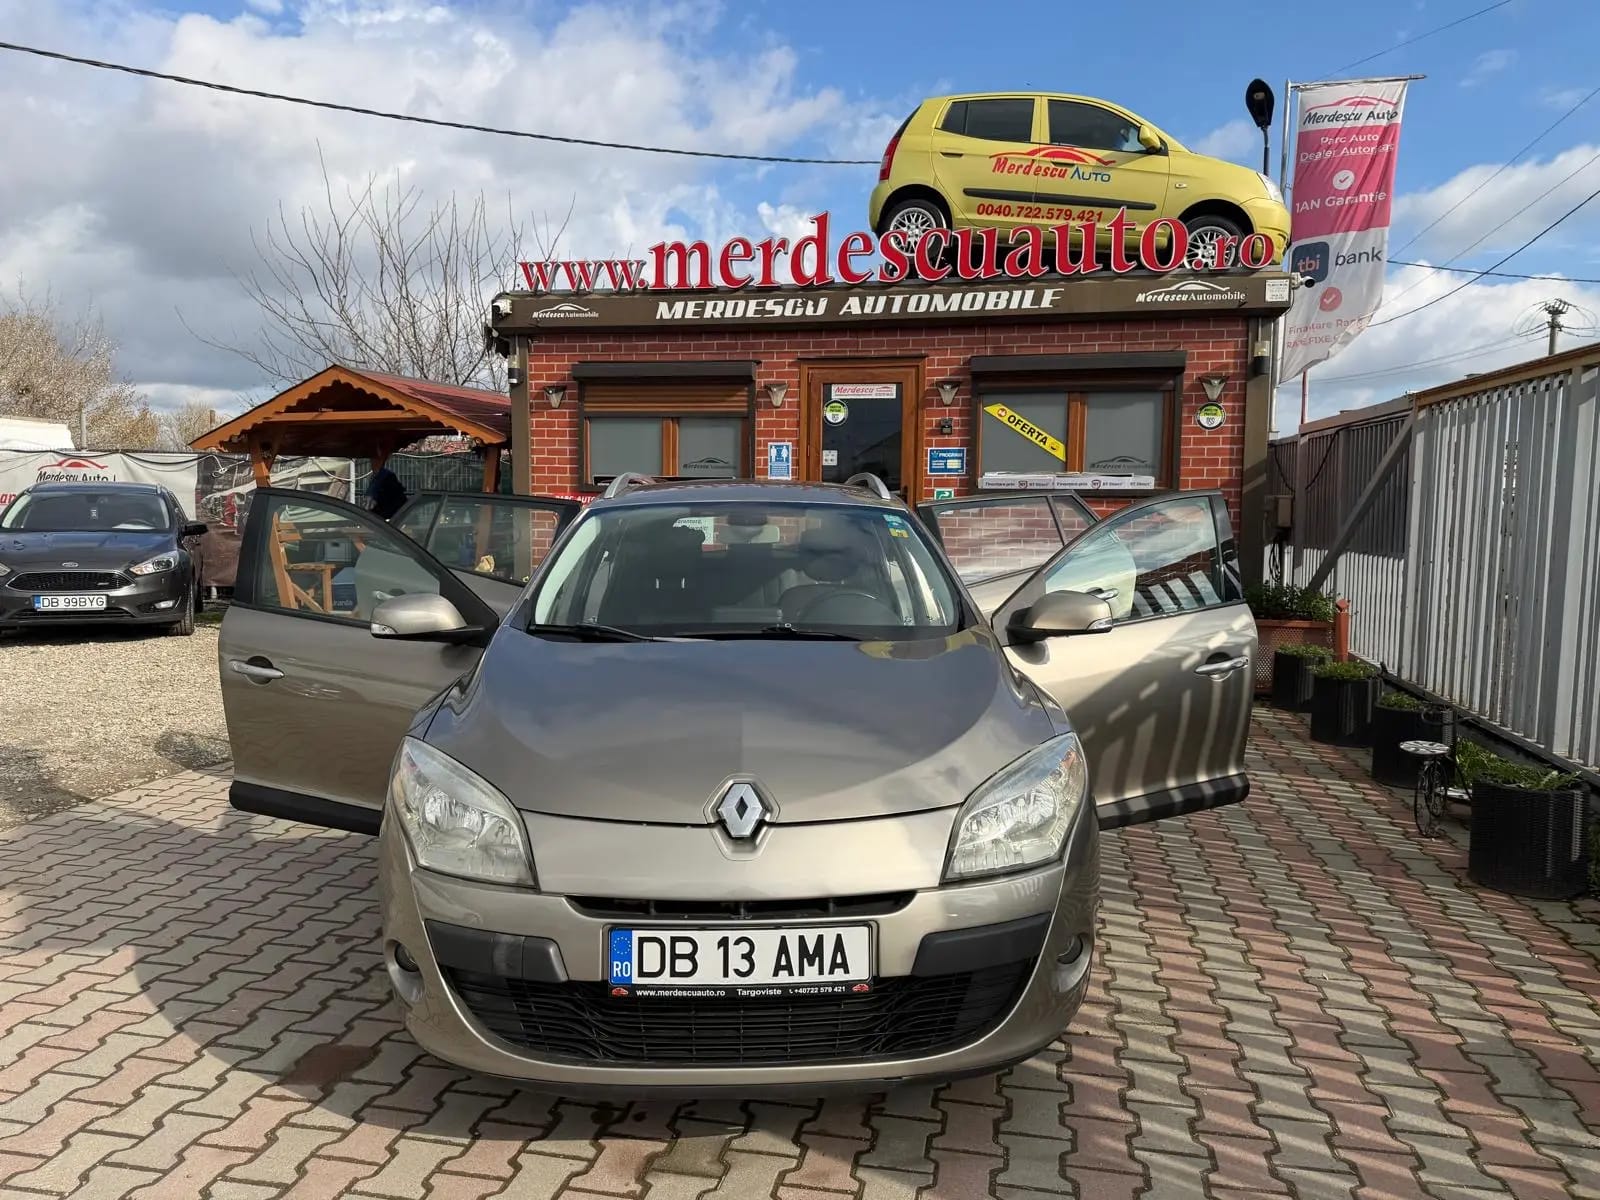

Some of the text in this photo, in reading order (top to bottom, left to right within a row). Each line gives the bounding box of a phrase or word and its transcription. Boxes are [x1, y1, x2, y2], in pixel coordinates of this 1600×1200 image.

[1303, 109, 1398, 125] Merdescu Auto
[1321, 133, 1379, 145] Parc Auto
[992, 157, 1067, 178] Merdescu
[1325, 191, 1387, 207] Garantie
[976, 203, 1104, 222] 0040.722.579.421
[519, 205, 1274, 292] www.merdescuauto.ro
[1298, 246, 1382, 272] tbi bank
[655, 288, 1064, 320] MERDESCU AUTOMOBILE
[834, 386, 875, 394] Merdescu
[1007, 414, 1048, 445] OFERTA
[42, 598, 59, 607] DB
[63, 597, 105, 607] 99BYG
[612, 933, 850, 978] RO DB 13 AMA
[636, 988, 725, 997] www.merdescuauto.ro
[737, 987, 782, 996] Targoviste
